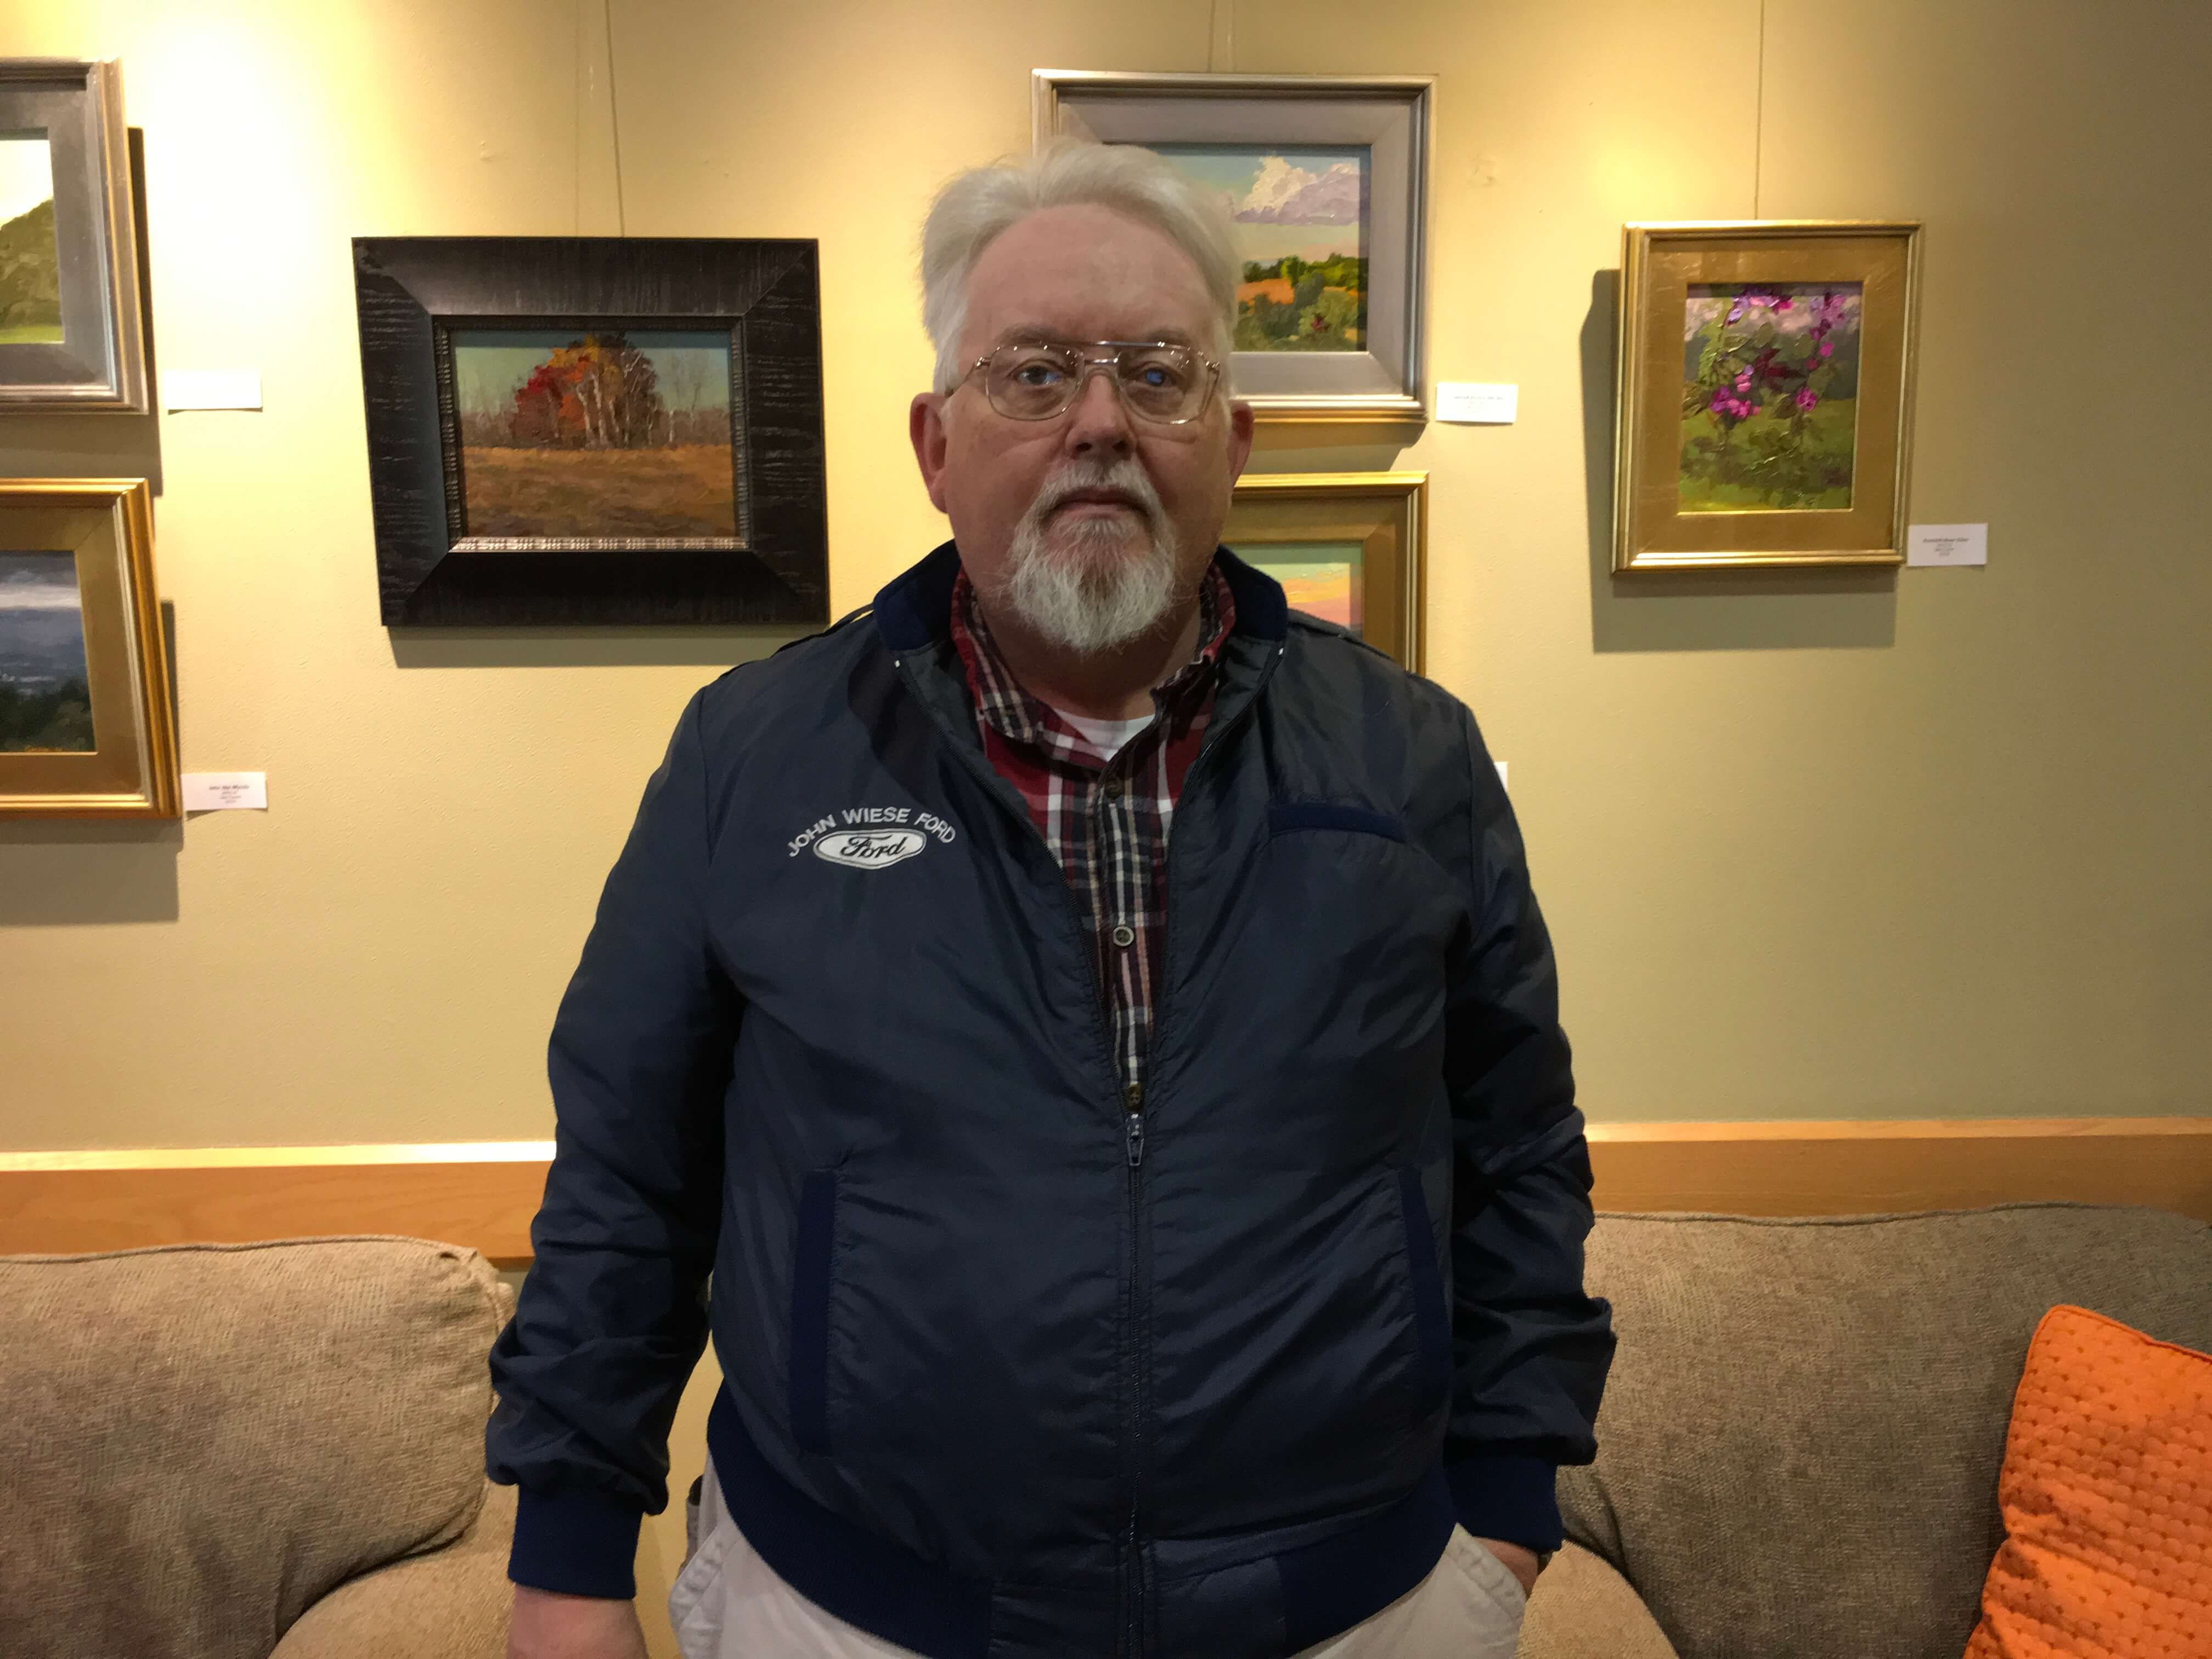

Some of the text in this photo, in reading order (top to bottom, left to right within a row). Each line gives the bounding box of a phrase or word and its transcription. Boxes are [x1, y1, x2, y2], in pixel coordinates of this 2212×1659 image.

[787, 806, 956, 857] JOHN WIESE FORD
[839, 834, 909, 859] Ford
